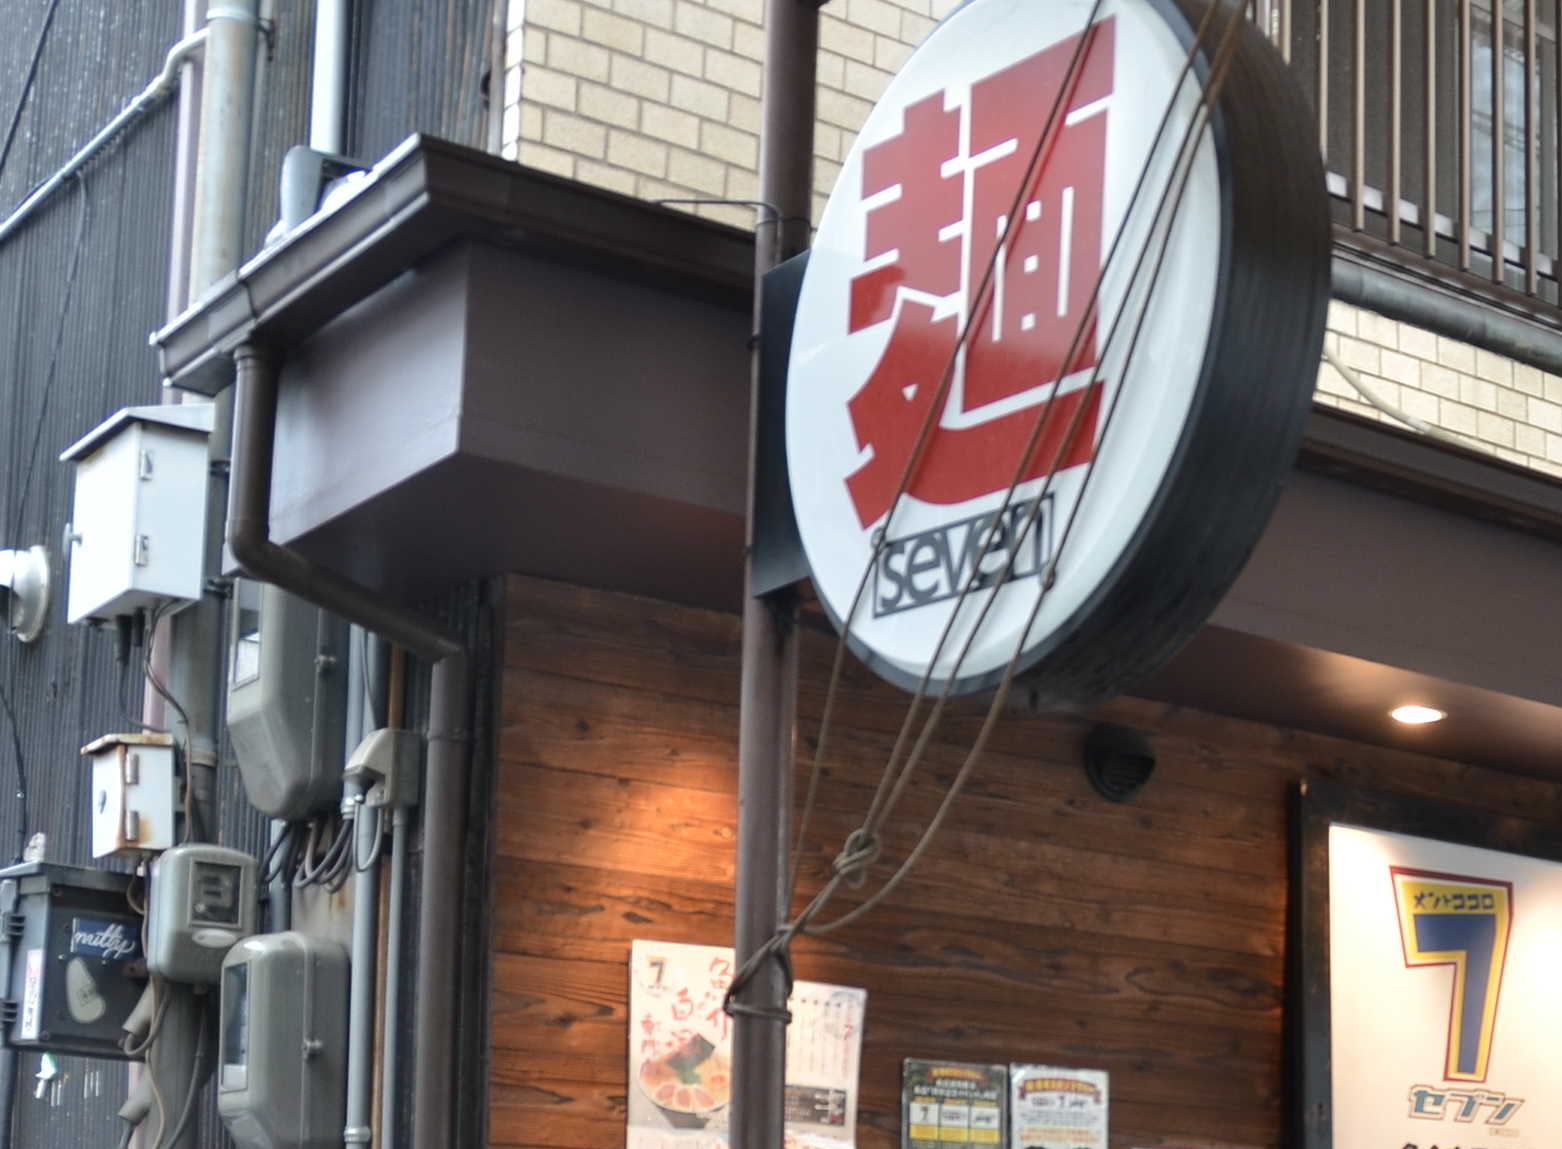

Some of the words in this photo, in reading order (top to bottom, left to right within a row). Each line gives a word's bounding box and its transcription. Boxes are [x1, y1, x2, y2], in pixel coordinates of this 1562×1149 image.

[844, 15, 1116, 530] 麺
[881, 502, 1050, 609] seven
[1400, 879, 1507, 1079] 7
[1408, 1084, 1525, 1125] セブン
